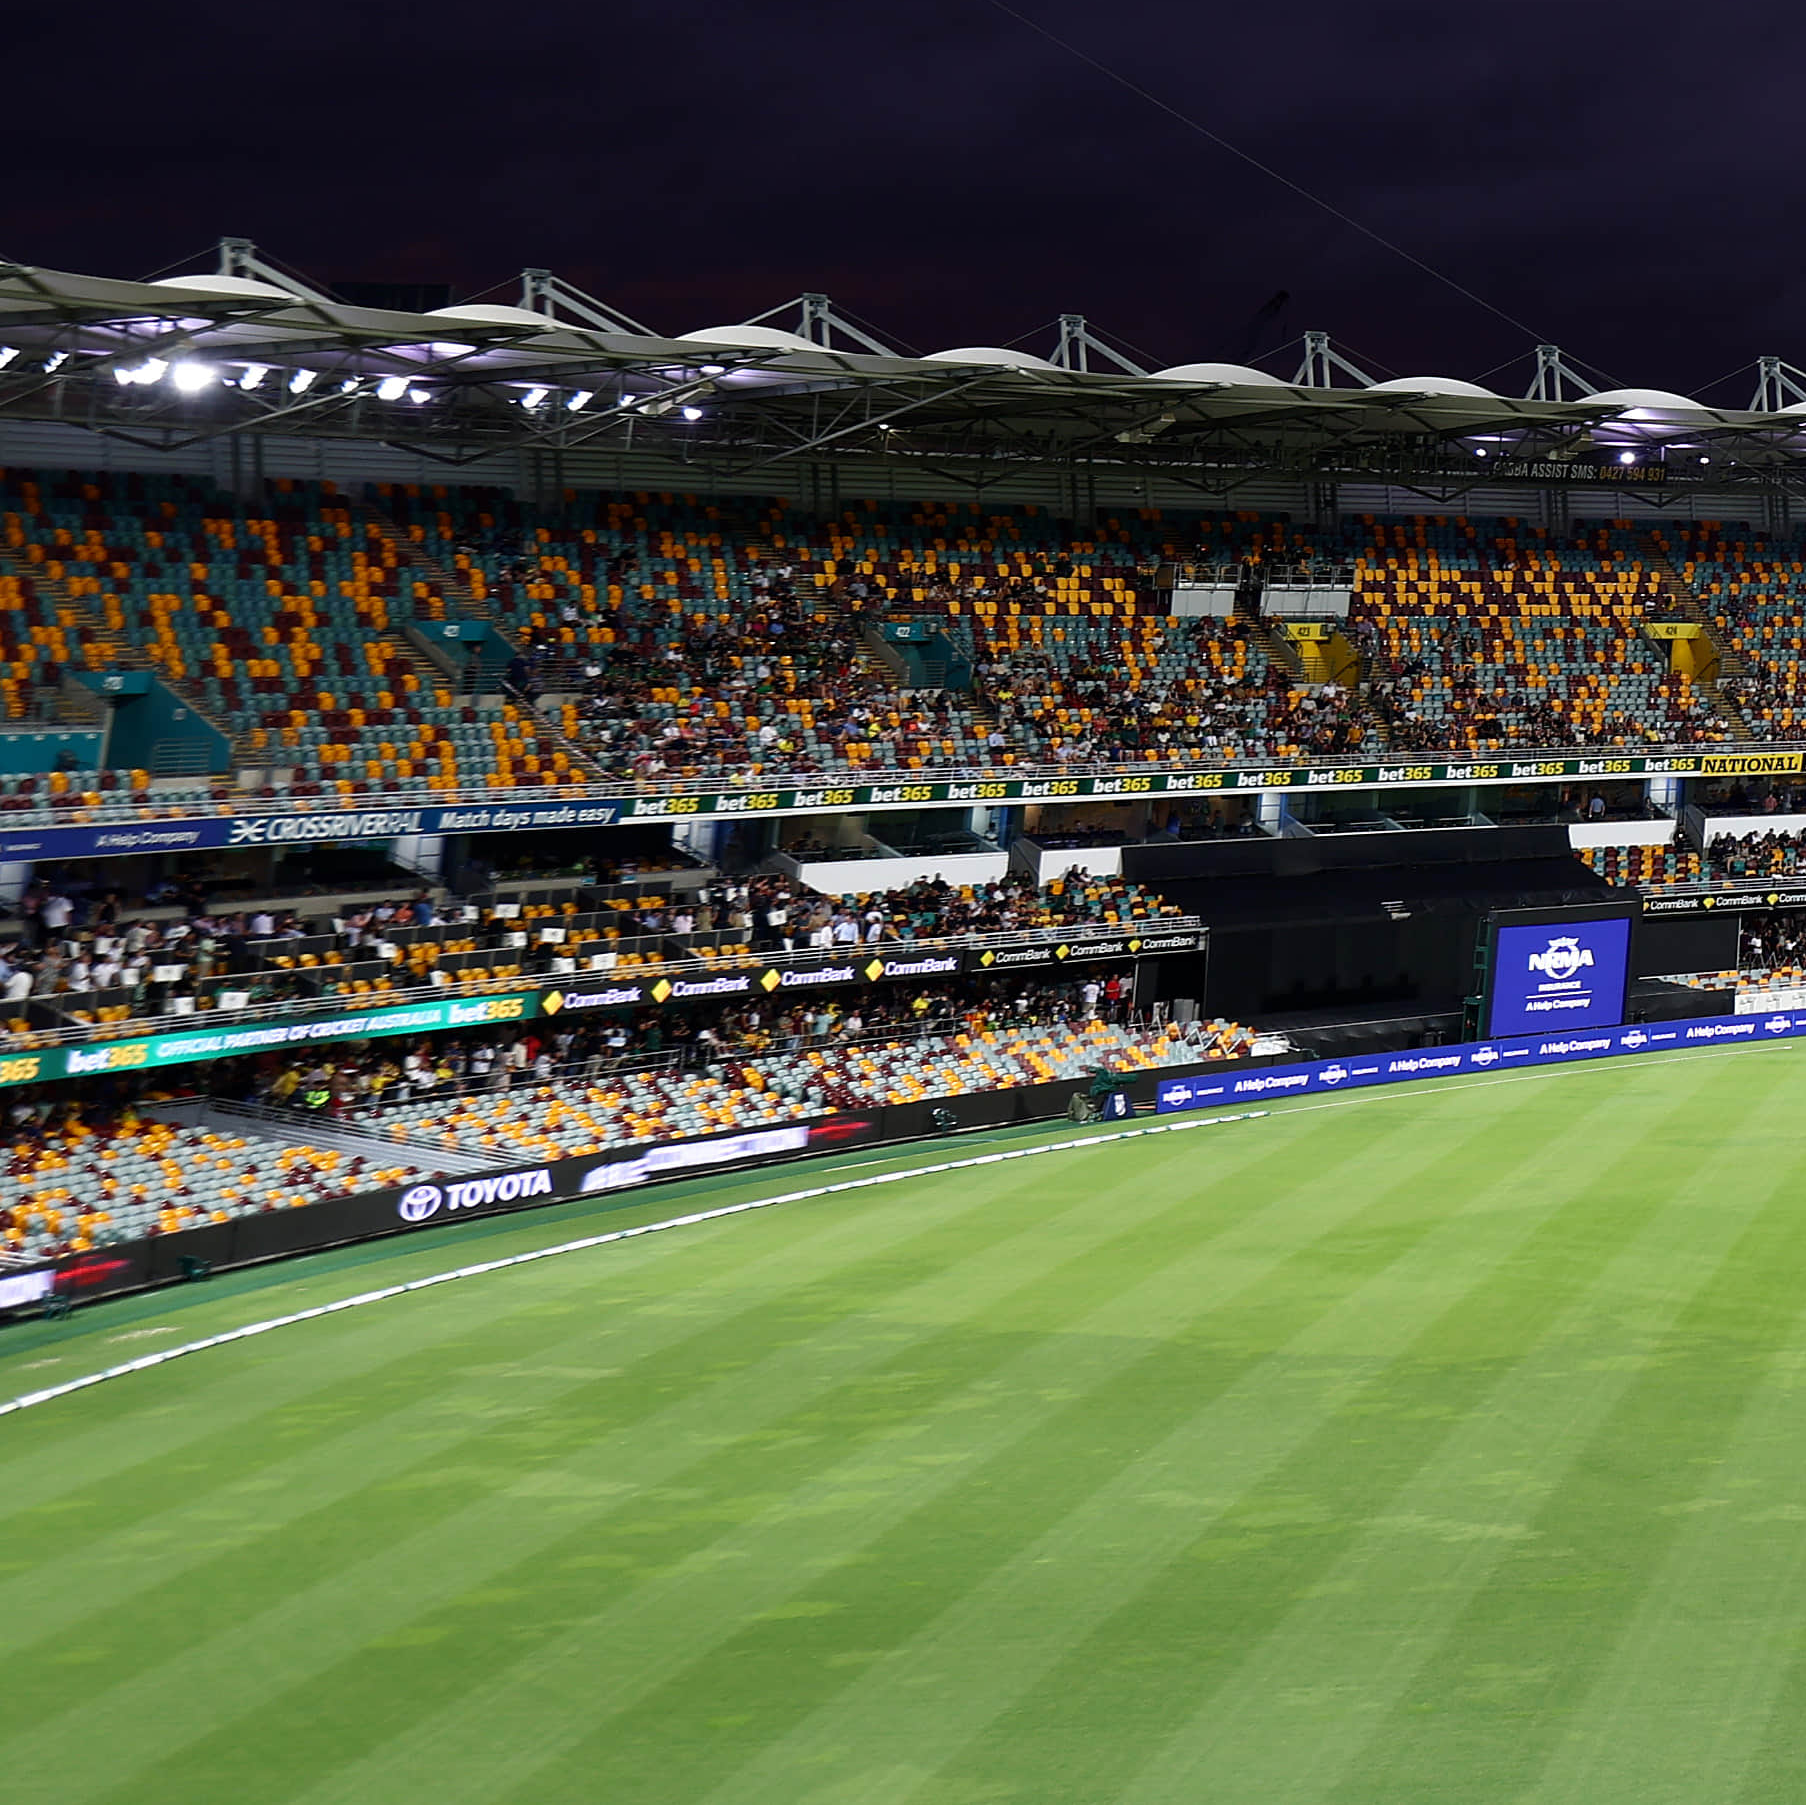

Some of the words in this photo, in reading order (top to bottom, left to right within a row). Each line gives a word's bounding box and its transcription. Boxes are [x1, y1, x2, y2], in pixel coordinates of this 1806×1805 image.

[1531, 464, 1568, 478] ASSIST
[1570, 465, 1598, 479] SMS:
[1648, 468, 1666, 481] 931
[1446, 764, 1498, 780] bet365
[1512, 761, 1564, 778] bet365
[1579, 759, 1630, 775] bet365
[1644, 757, 1696, 773] bet365
[1703, 756, 1798, 774] NATIONAL
[1167, 774, 1223, 790] bet365
[1237, 772, 1291, 787] bet365
[1308, 769, 1363, 785] bet365
[1378, 766, 1432, 782] bet365
[948, 782, 1007, 801] bet365
[1022, 780, 1078, 797] bet365
[1093, 777, 1151, 794] bet365
[715, 793, 779, 811] bet365
[794, 788, 853, 807] bet365
[870, 786, 931, 804] bet365
[633, 798, 699, 816] bet365
[439, 810, 492, 830] Match
[494, 810, 530, 831] days
[532, 808, 577, 825] made
[578, 807, 616, 825] easy
[1650, 898, 1698, 910] CommBank
[1070, 941, 1124, 956] CommBank
[1142, 935, 1196, 950] CommBank
[996, 948, 1051, 964] CommBank
[1528, 949, 1594, 971] NRMA
[885, 956, 956, 976] CommBank
[781, 966, 854, 987] CommBank
[672, 976, 750, 998] CommBank
[564, 987, 641, 1010] CommBank
[448, 998, 525, 1024] bet365
[444, 1169, 553, 1210] TOYOTA
